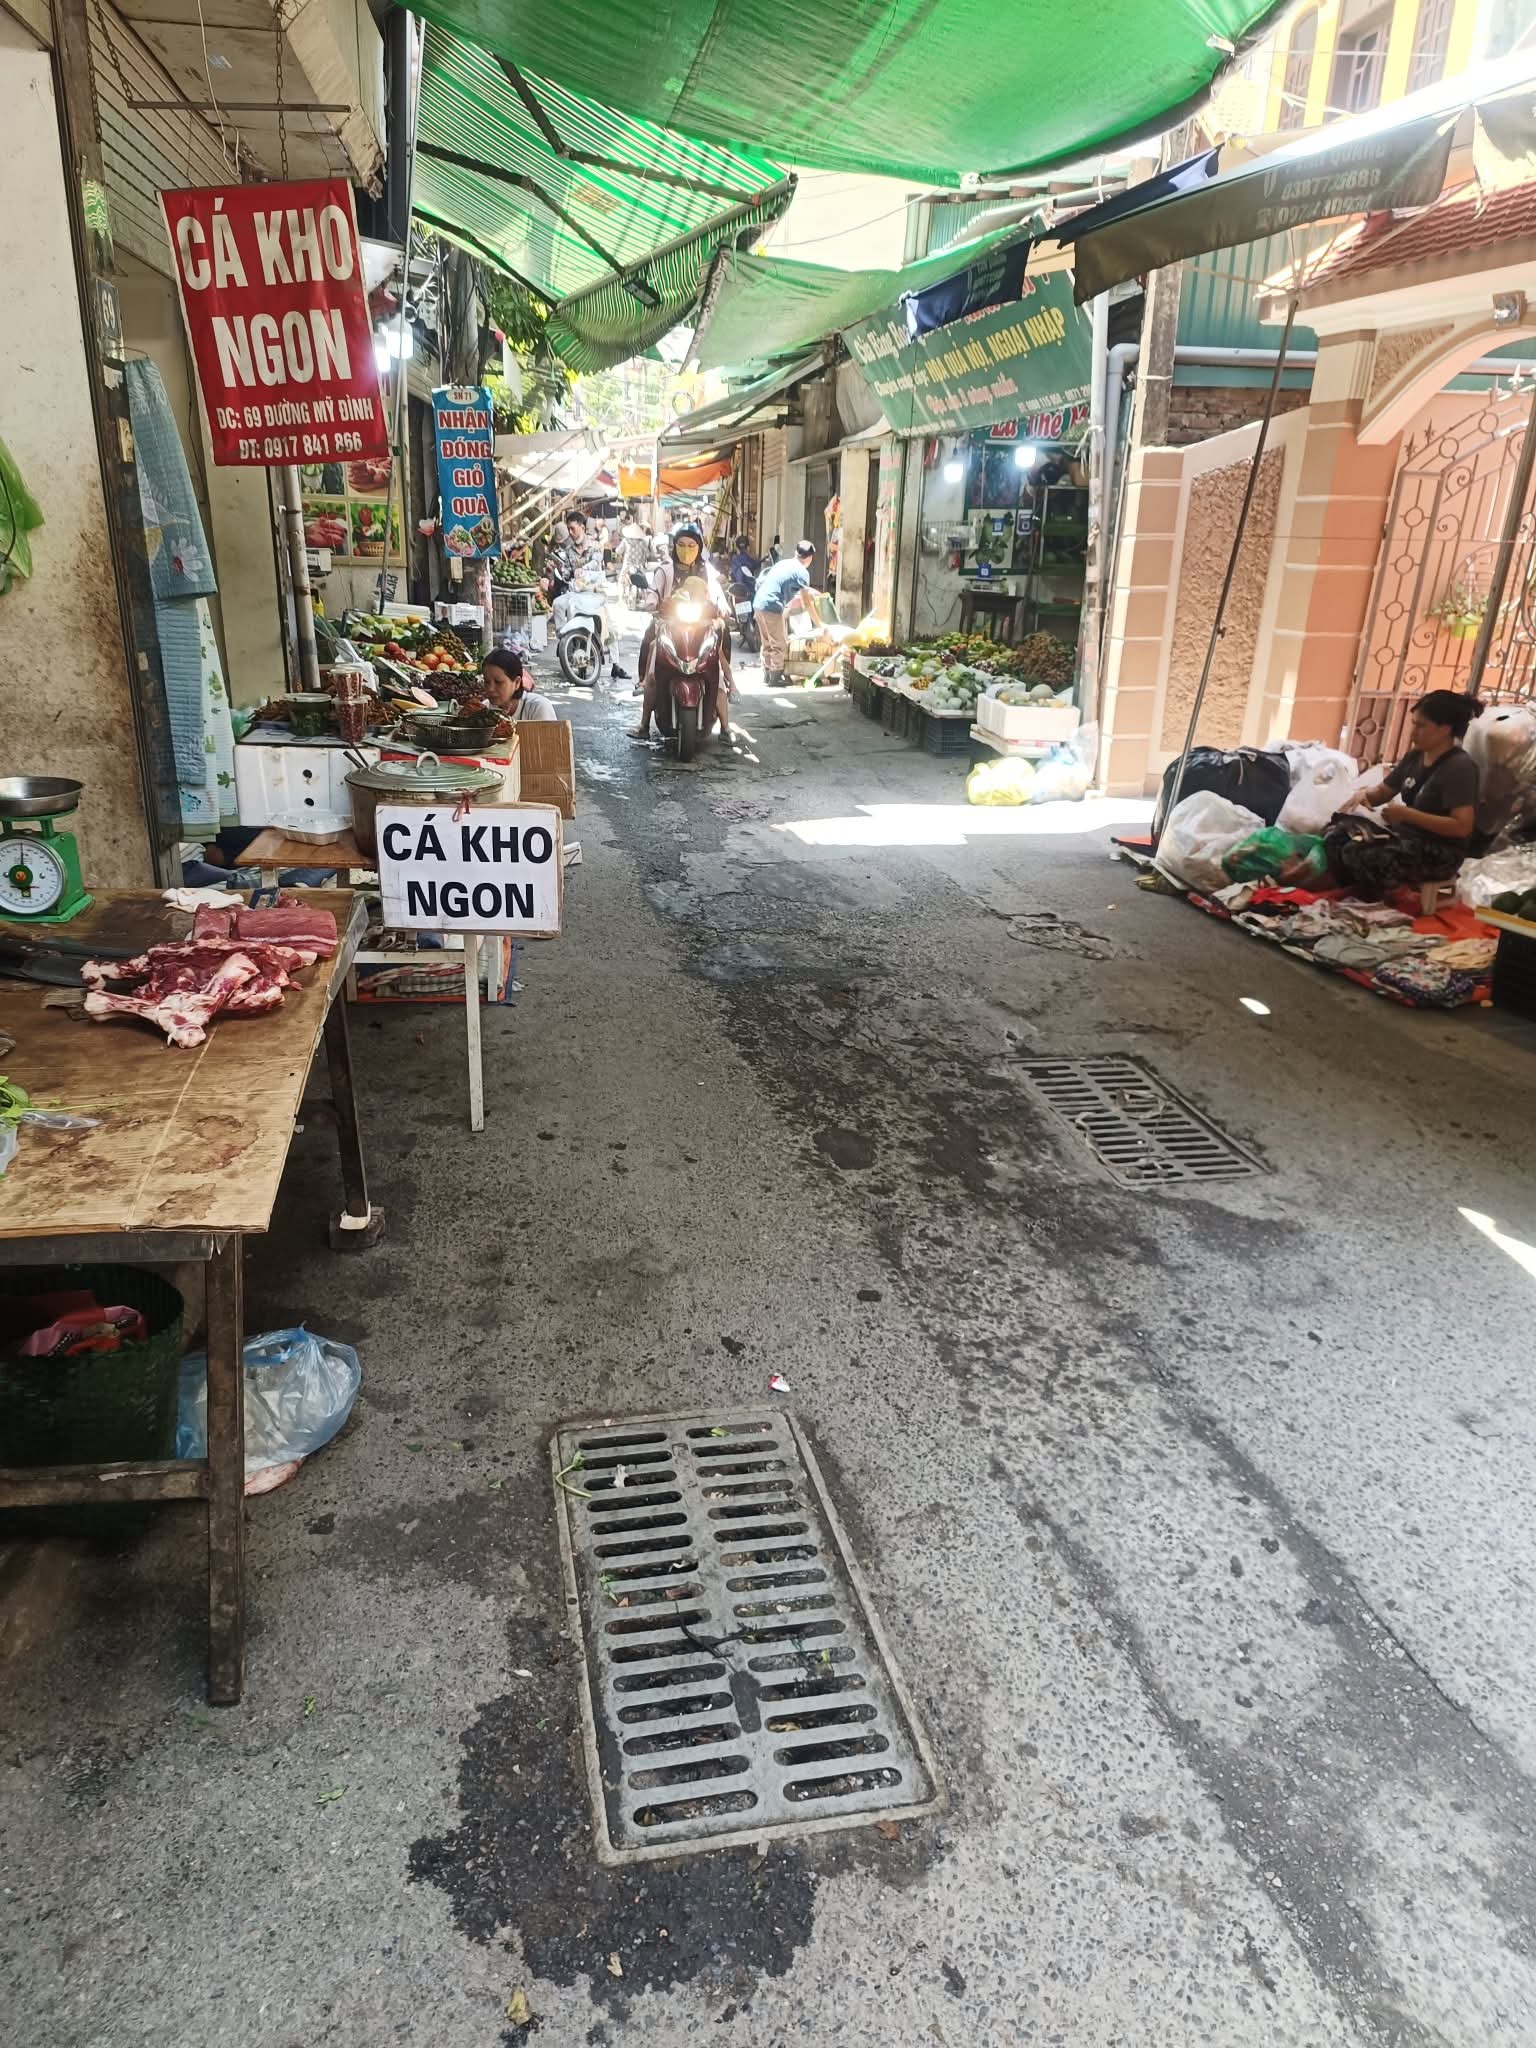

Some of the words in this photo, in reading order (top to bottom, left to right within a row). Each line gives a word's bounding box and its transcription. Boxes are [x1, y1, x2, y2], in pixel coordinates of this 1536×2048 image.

[176, 197, 249, 291] CÁ
[253, 204, 354, 286] KHO
[211, 308, 352, 388] NGON
[986, 323, 1031, 362] NGOẠI
[1023, 305, 1066, 348] NHẬP
[243, 405, 262, 428] 69
[263, 397, 311, 427] ĐƯỜNG
[312, 395, 335, 424] MỸ
[337, 393, 375, 422] ĐÌNH
[437, 406, 489, 433] NHẬN
[263, 435, 298, 459] 0917
[302, 433, 330, 457] 841
[440, 436, 493, 459] ĐÓNG
[452, 463, 485, 487] GIỎ
[452, 493, 491, 517] QUÀ
[382, 813, 447, 862] CÁ
[461, 825, 553, 864] KHO
[406, 880, 534, 918] NGON
